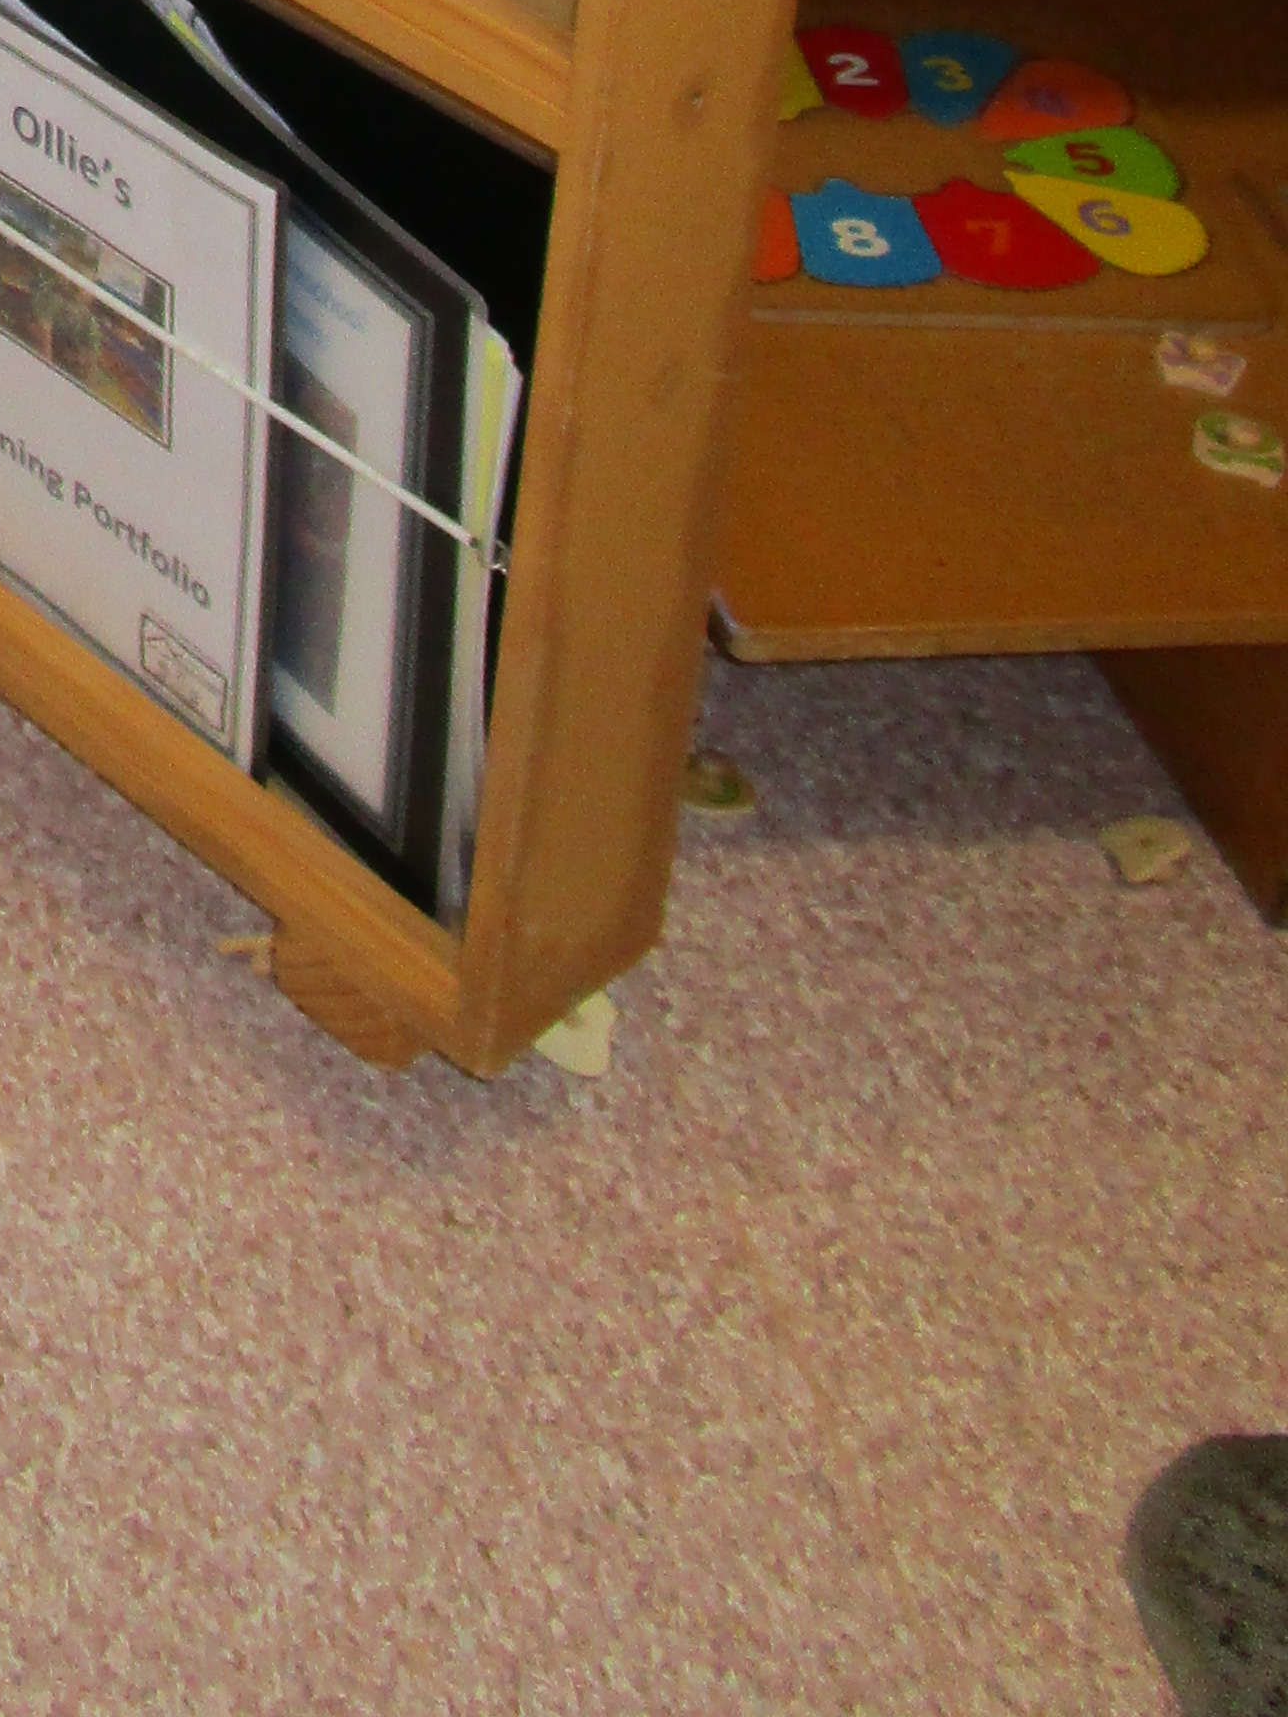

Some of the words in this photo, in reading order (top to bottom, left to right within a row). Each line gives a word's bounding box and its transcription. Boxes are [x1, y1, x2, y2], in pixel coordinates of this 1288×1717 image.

[826, 51, 880, 88] 2
[923, 56, 974, 92] 3
[12, 104, 133, 210] Ollie's
[1064, 141, 1116, 177] 5
[829, 217, 892, 259] 8
[965, 218, 1012, 256] 7
[1077, 199, 1133, 237] 6
[73, 479, 213, 612] Portfolio
